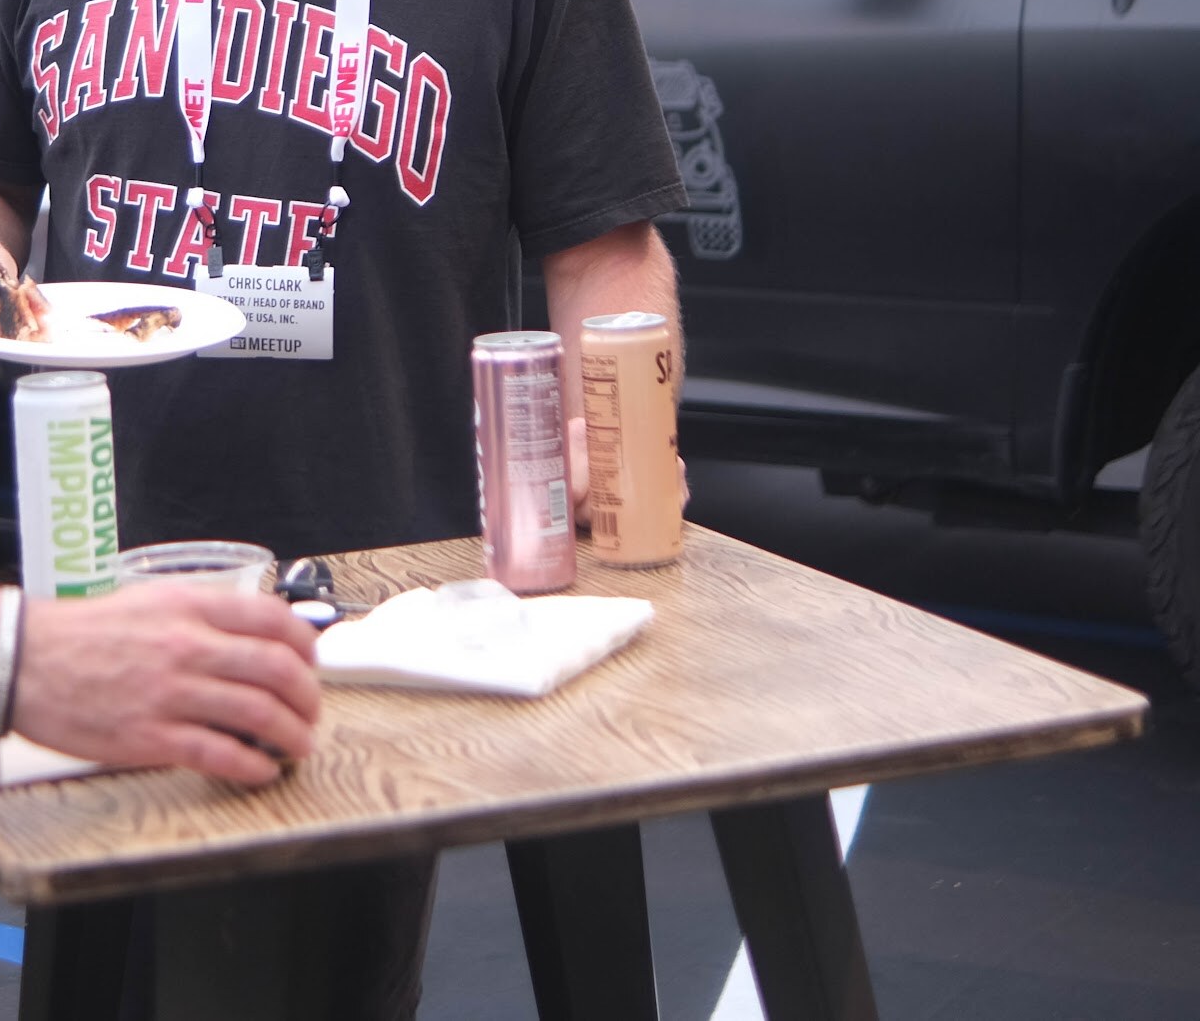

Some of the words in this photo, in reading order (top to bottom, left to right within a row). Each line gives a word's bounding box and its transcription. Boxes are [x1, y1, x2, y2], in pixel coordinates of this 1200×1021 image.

[228, 277, 263, 290] CHRIS
[265, 278, 303, 292] CLARK
[253, 297, 277, 308] HEAD
[279, 298, 292, 309] OF
[293, 299, 325, 310] BRAND
[256, 313, 277, 325] USA,
[279, 314, 298, 325] INC.
[248, 337, 302, 353] MEETUP
